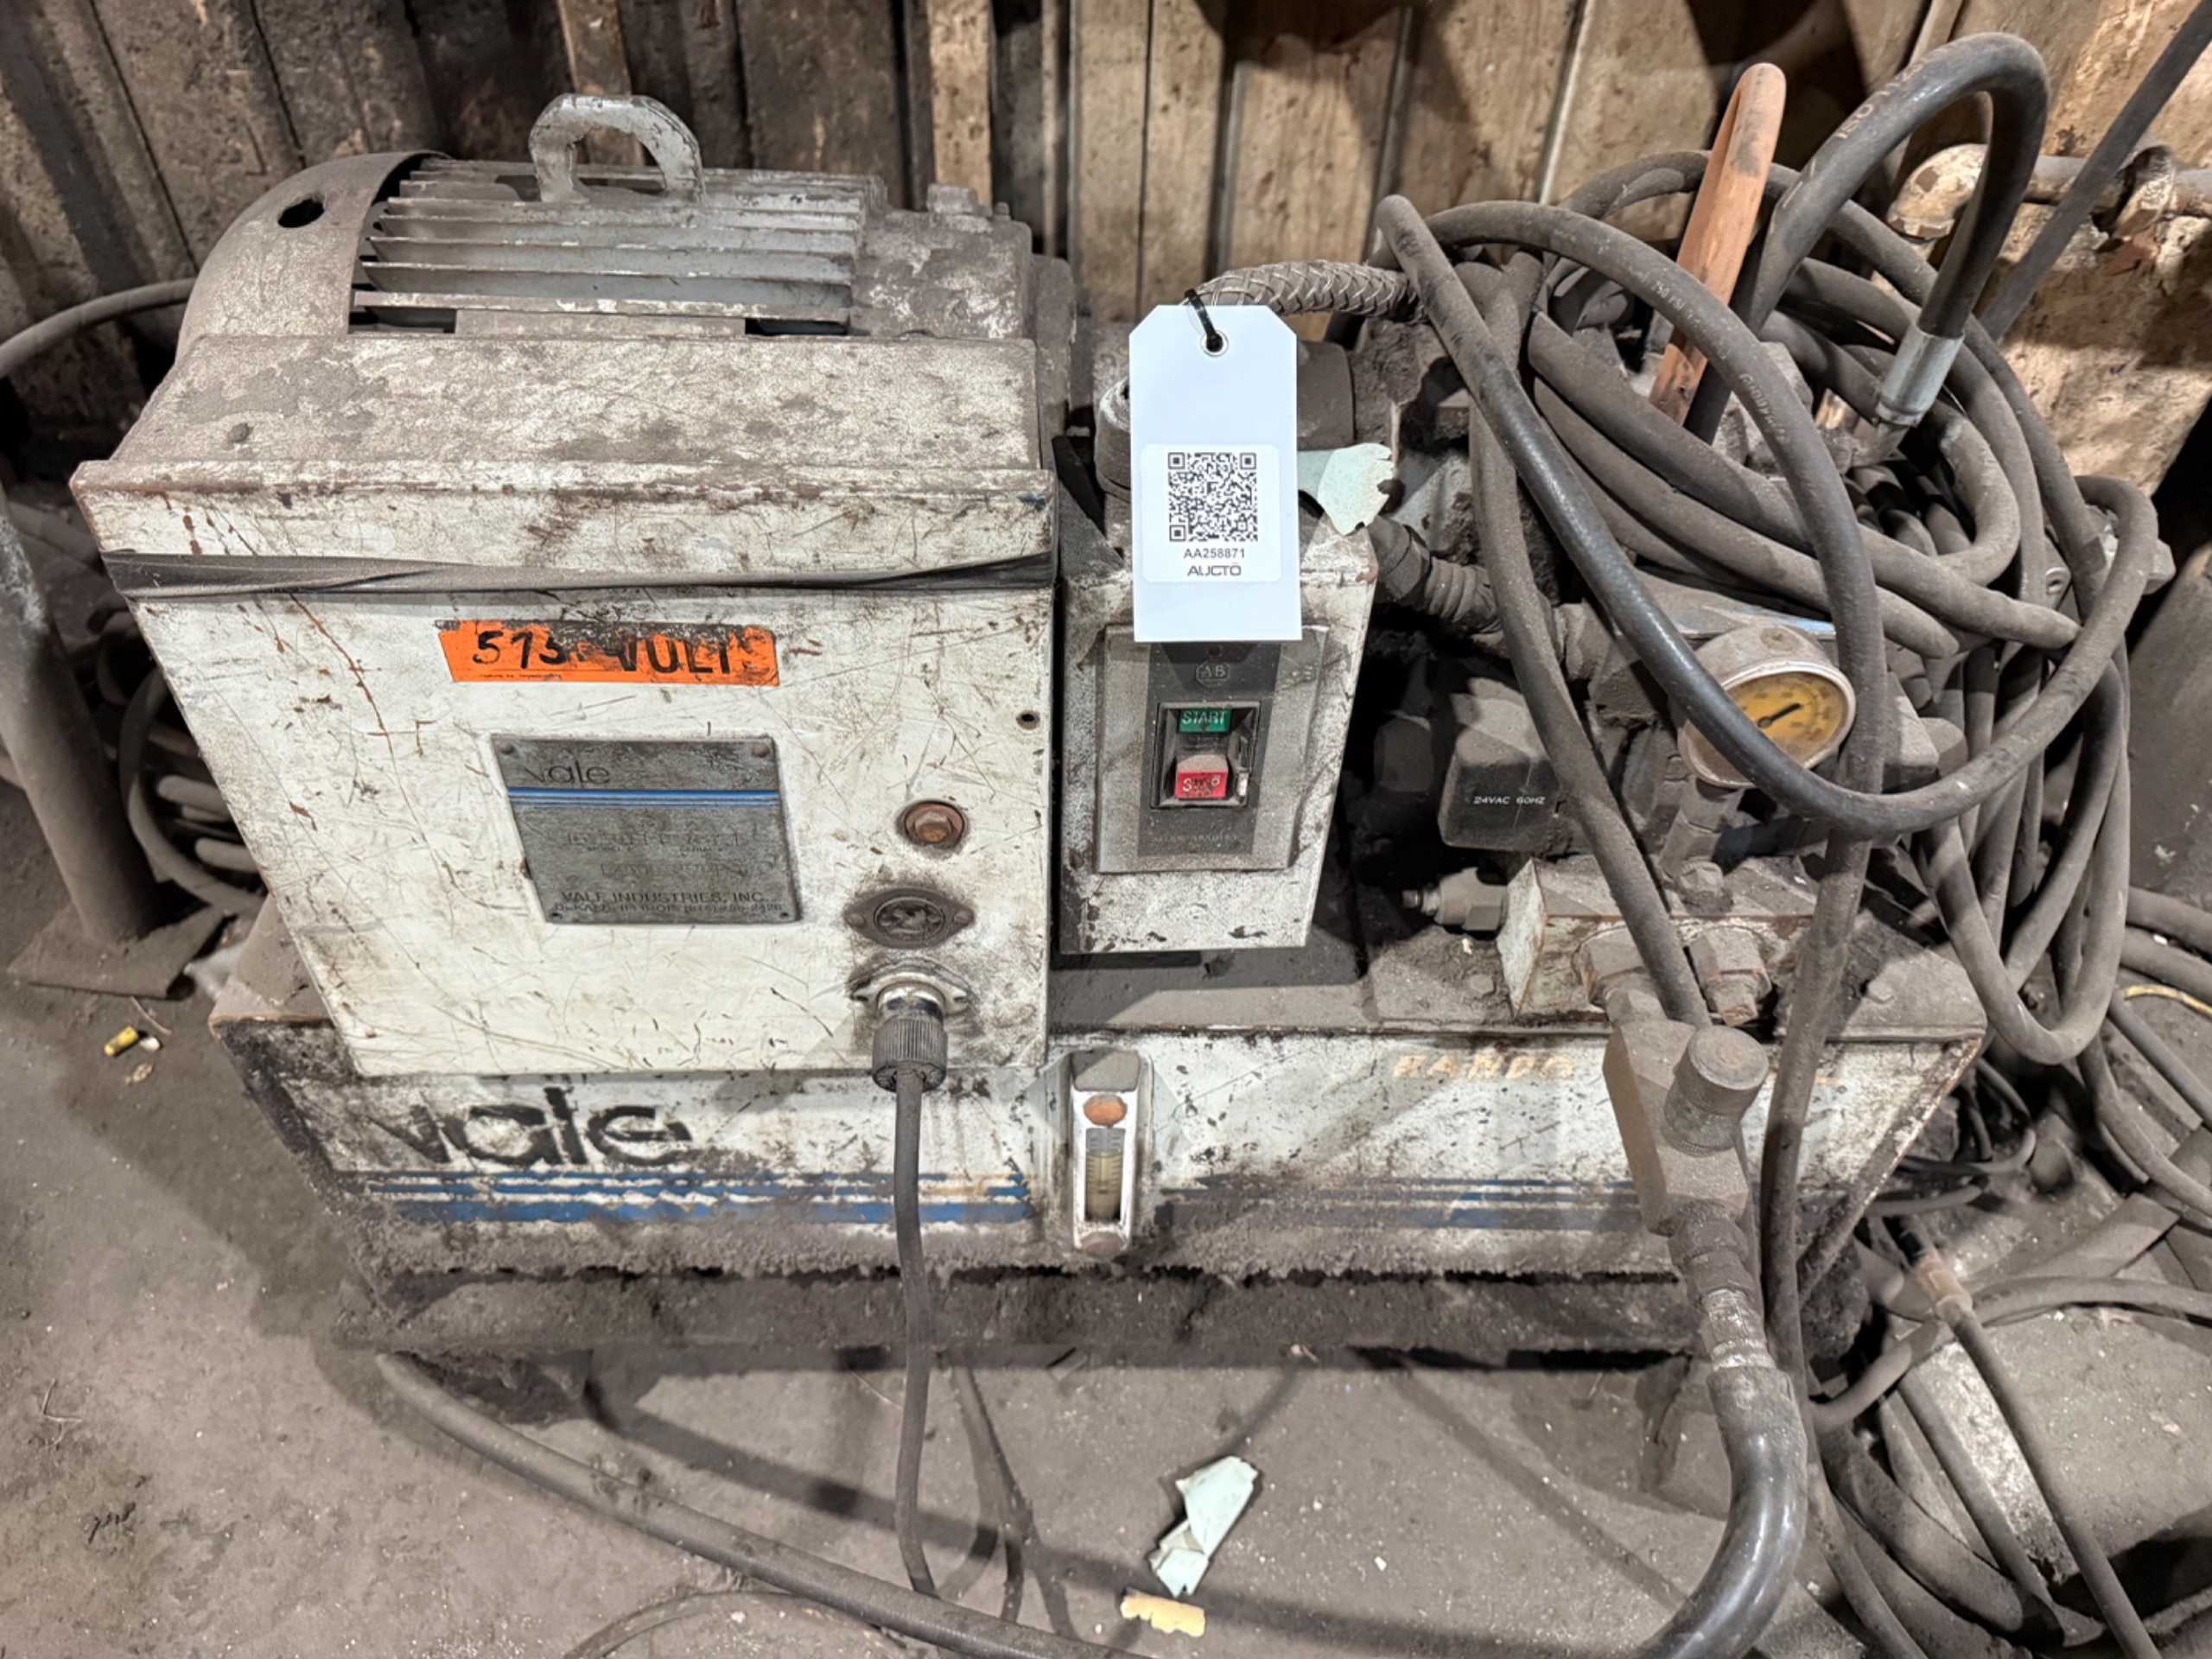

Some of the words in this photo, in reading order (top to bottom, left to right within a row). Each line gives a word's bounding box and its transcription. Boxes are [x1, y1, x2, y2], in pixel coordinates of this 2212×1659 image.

[1183, 547, 1245, 559] AA258871
[1182, 710, 1228, 724] START
[1473, 796, 1510, 804] 24VAC
